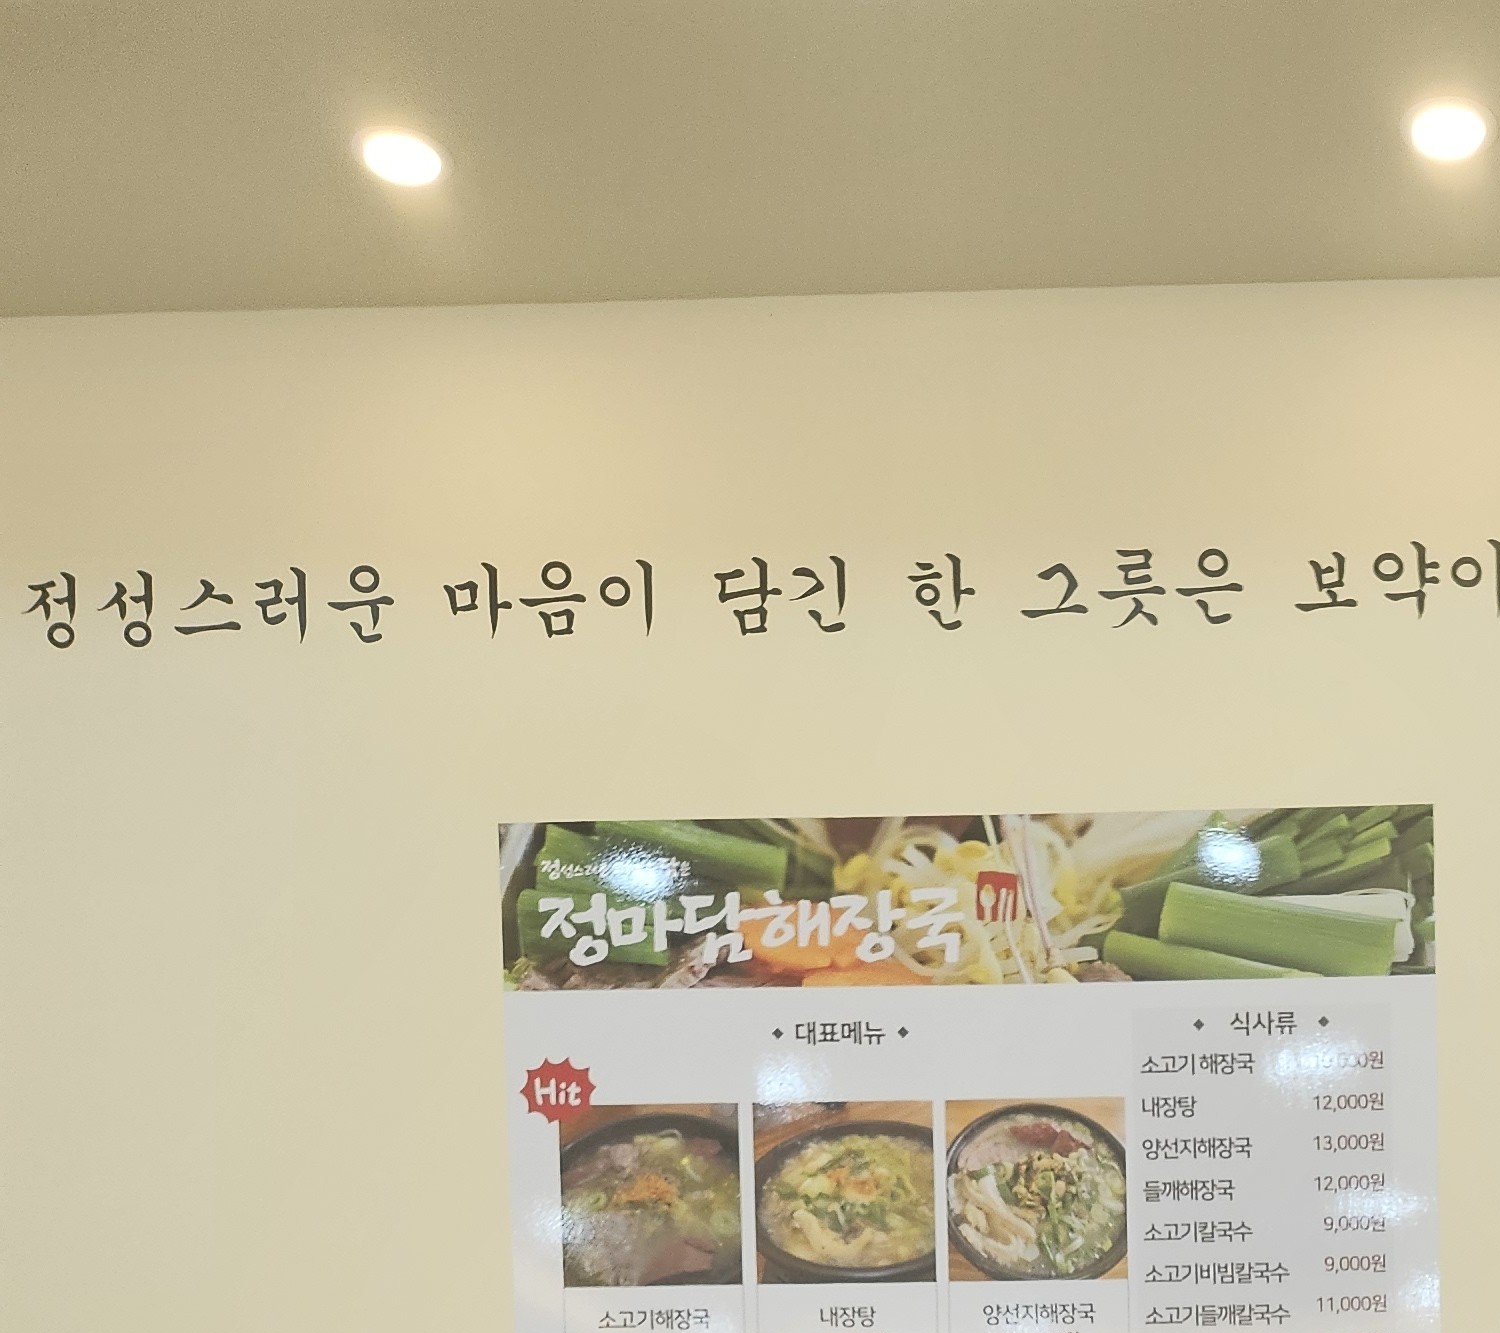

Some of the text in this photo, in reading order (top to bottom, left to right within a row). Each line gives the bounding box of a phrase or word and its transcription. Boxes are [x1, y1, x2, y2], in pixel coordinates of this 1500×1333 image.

[26, 562, 395, 650] 정성스러운
[444, 558, 653, 640] 마음이
[715, 554, 846, 635] 담긴
[906, 553, 976, 632] 한
[1021, 547, 1244, 628] 그릇은
[538, 888, 965, 967] 정마담해장국
[795, 1021, 886, 1046] 대표메뉴
[1229, 1011, 1298, 1036] 식사류
[533, 1076, 582, 1107] Hit
[1313, 1092, 1385, 1112] 12,000원
[1141, 1095, 1197, 1119] 내장탕
[1142, 1137, 1253, 1160] 양선지해장국
[1313, 1132, 1385, 1153] 13,000원
[1143, 1178, 1236, 1203] 들깨해장국
[1313, 1172, 1386, 1194] 12,000원
[1144, 1220, 1254, 1243] 소고기칼국수
[1323, 1214, 1386, 1234] 9,000원
[1144, 1261, 1290, 1285] 소고기비빔칼국수
[1324, 1253, 1387, 1275] 9,000원
[982, 1302, 1097, 1326] 양선지해장국
[1145, 1303, 1291, 1327] 소고기들깨칼국수
[1316, 1293, 1388, 1315] 11,000원
[598, 1307, 711, 1331] 소고기해장국
[819, 1305, 876, 1328] 내장탕
